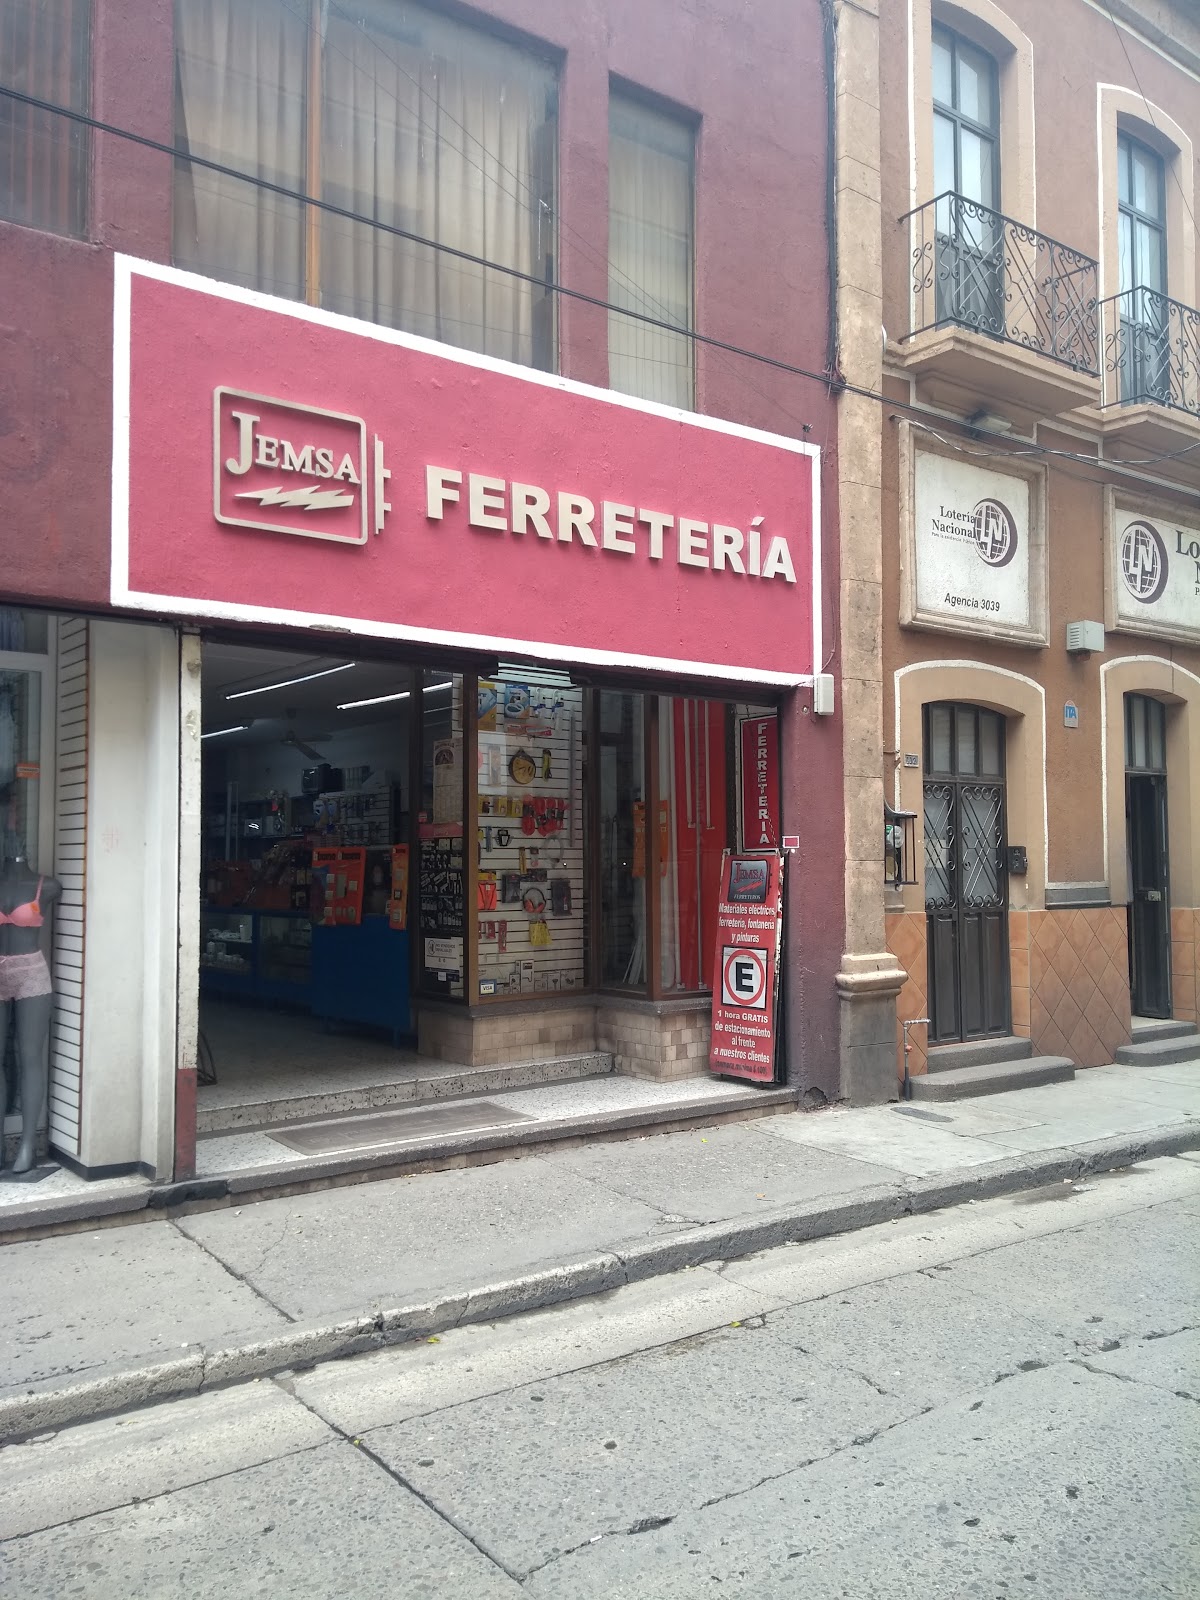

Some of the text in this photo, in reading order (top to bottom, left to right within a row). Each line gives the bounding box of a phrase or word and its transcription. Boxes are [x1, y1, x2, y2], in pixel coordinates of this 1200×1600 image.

[226, 410, 361, 485] JEMSA
[425, 464, 797, 583] FERRETERÍA
[939, 505, 976, 524] Lotería
[931, 519, 976, 539] Nacional
[944, 593, 1000, 612] Agencia 3039
[757, 722, 770, 844] FERRETERIA
[733, 863, 765, 884] JEMSA
[719, 903, 748, 915] Materiales
[747, 918, 775, 930] fontanería
[731, 932, 760, 943] y pinturas
[735, 962, 754, 993] E
[724, 1010, 741, 1020] hora
[742, 1012, 769, 1024] GRATIS
[714, 1021, 771, 1038] de estacionamiento
[731, 1036, 756, 1048] al frente
[714, 1047, 770, 1063] a nuestros clientes
